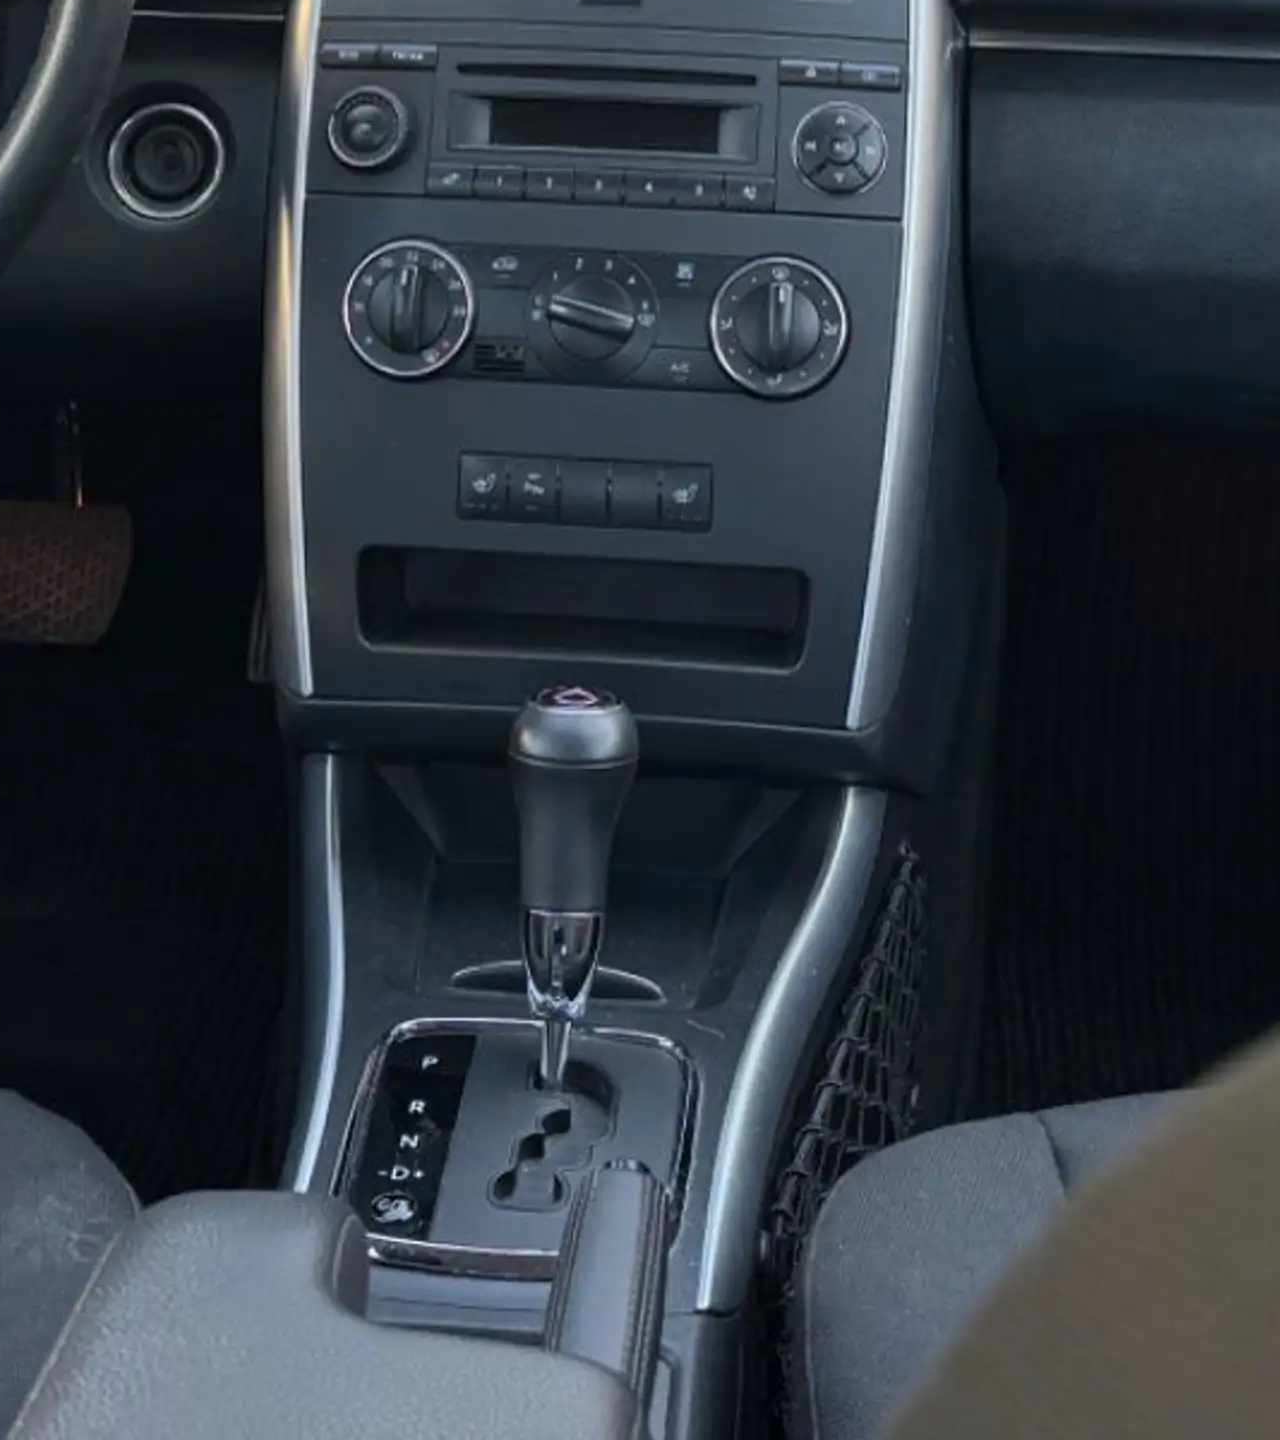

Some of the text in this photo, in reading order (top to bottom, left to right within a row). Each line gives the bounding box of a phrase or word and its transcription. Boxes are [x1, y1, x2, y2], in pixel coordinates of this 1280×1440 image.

[422, 1055, 439, 1069] P
[408, 1099, 427, 1114] R
[400, 1134, 419, 1149] N
